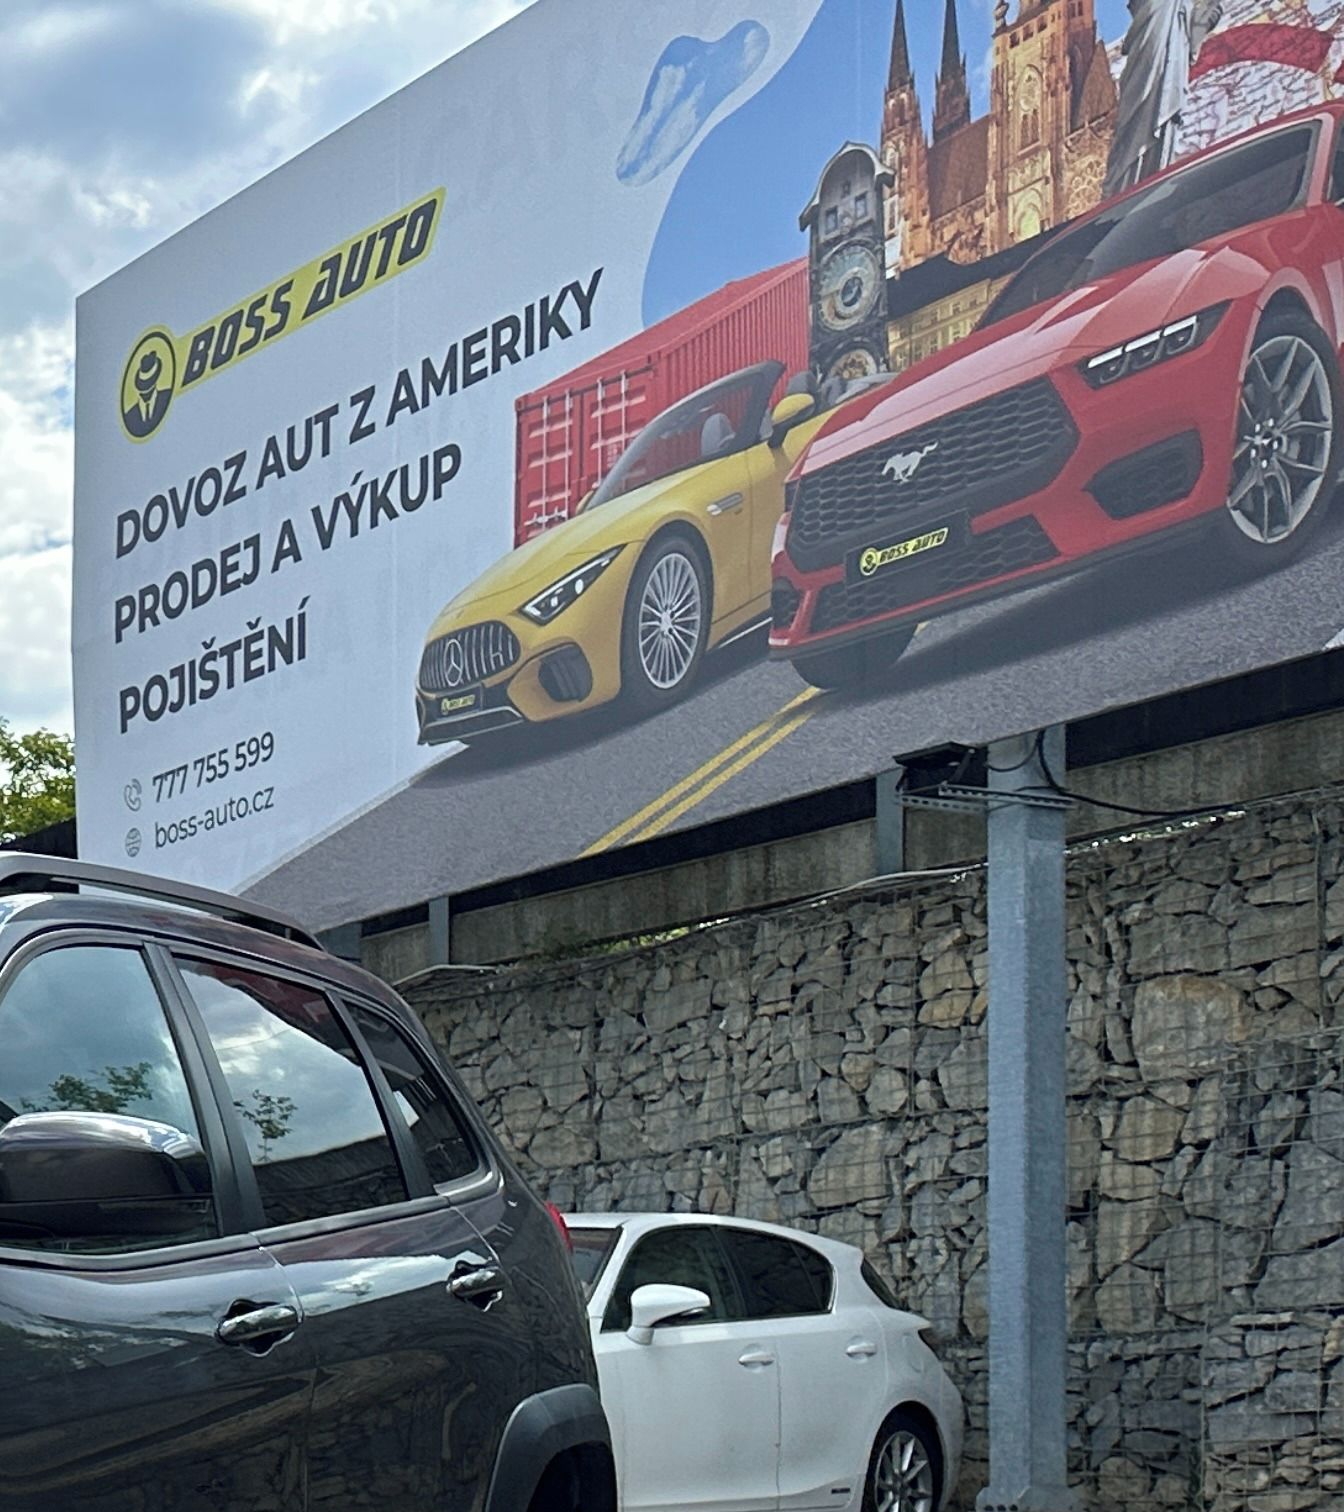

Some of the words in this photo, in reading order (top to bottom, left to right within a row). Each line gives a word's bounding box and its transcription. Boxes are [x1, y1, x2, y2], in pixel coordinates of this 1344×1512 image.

[181, 279, 293, 388] BOSS
[302, 197, 438, 320] AUTO
[114, 450, 248, 559] DOVOZ
[255, 402, 340, 491] AUT
[348, 385, 376, 446] Z
[385, 266, 605, 427] AMERIKY
[114, 540, 261, 645] PRODEJ
[271, 518, 302, 574] A
[311, 442, 463, 551] VÝKUP
[118, 595, 311, 735] POJIŠTĚNÍ
[152, 763, 189, 803] 777
[193, 748, 230, 788] 755
[234, 731, 275, 772] 599
[154, 786, 275, 849] boss-auto.cz
